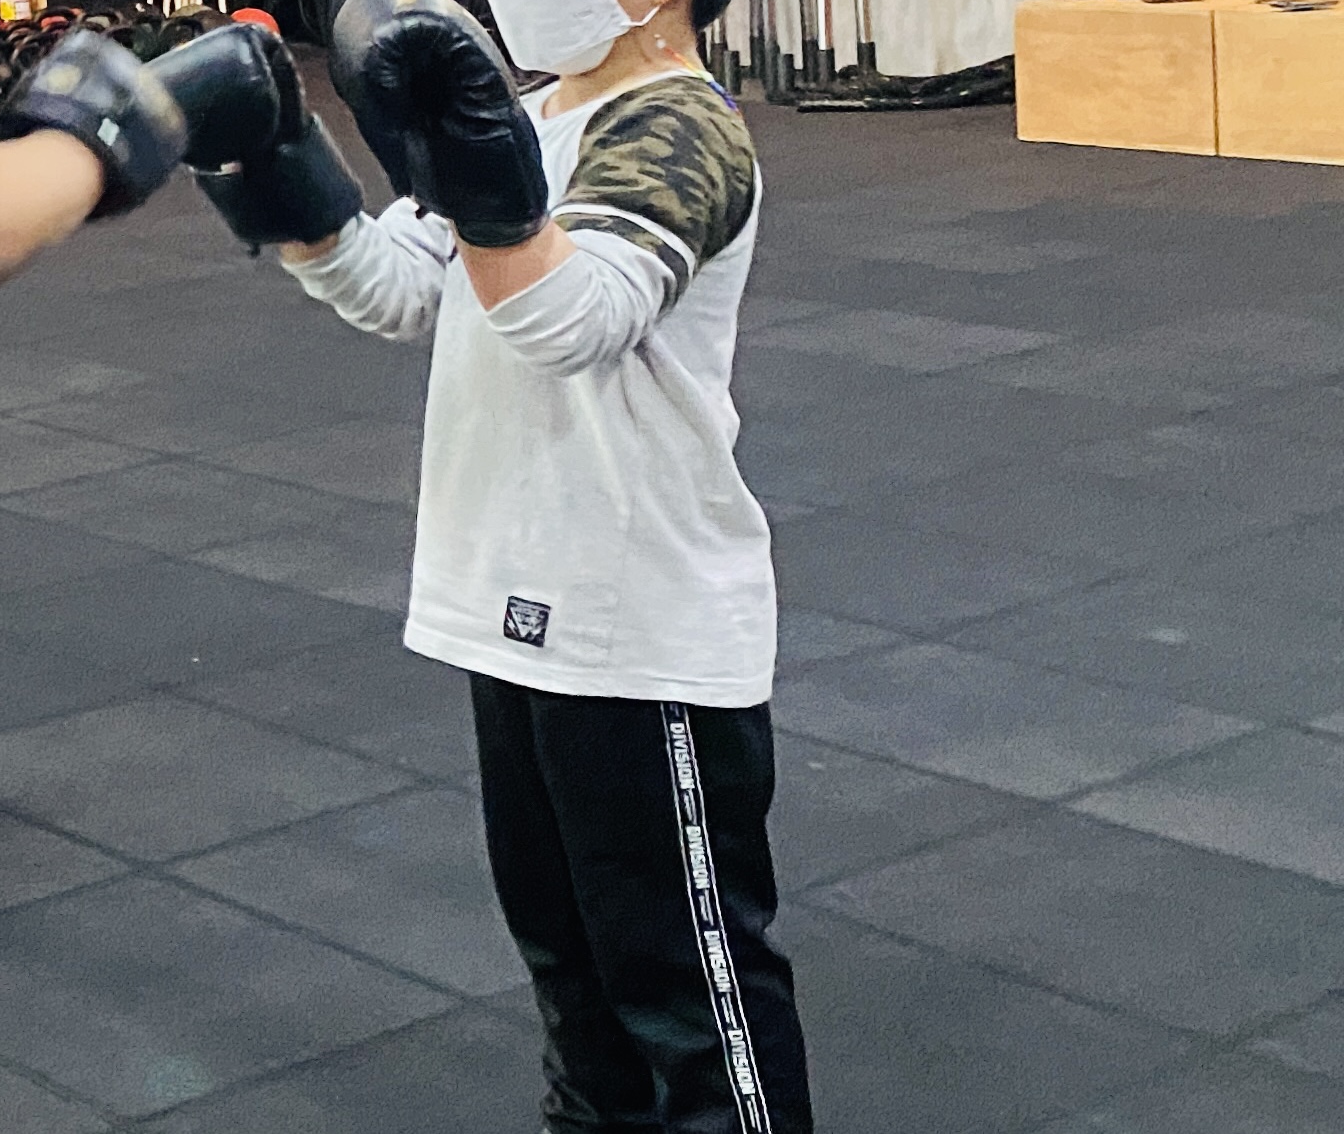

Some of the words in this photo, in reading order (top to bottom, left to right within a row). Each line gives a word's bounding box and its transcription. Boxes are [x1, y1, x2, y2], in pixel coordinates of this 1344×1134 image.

[670, 722, 695, 789] DIVISION
[686, 825, 711, 889] DIVISION
[704, 930, 733, 993] DIVISION
[728, 1029, 755, 1095] DIVISION
